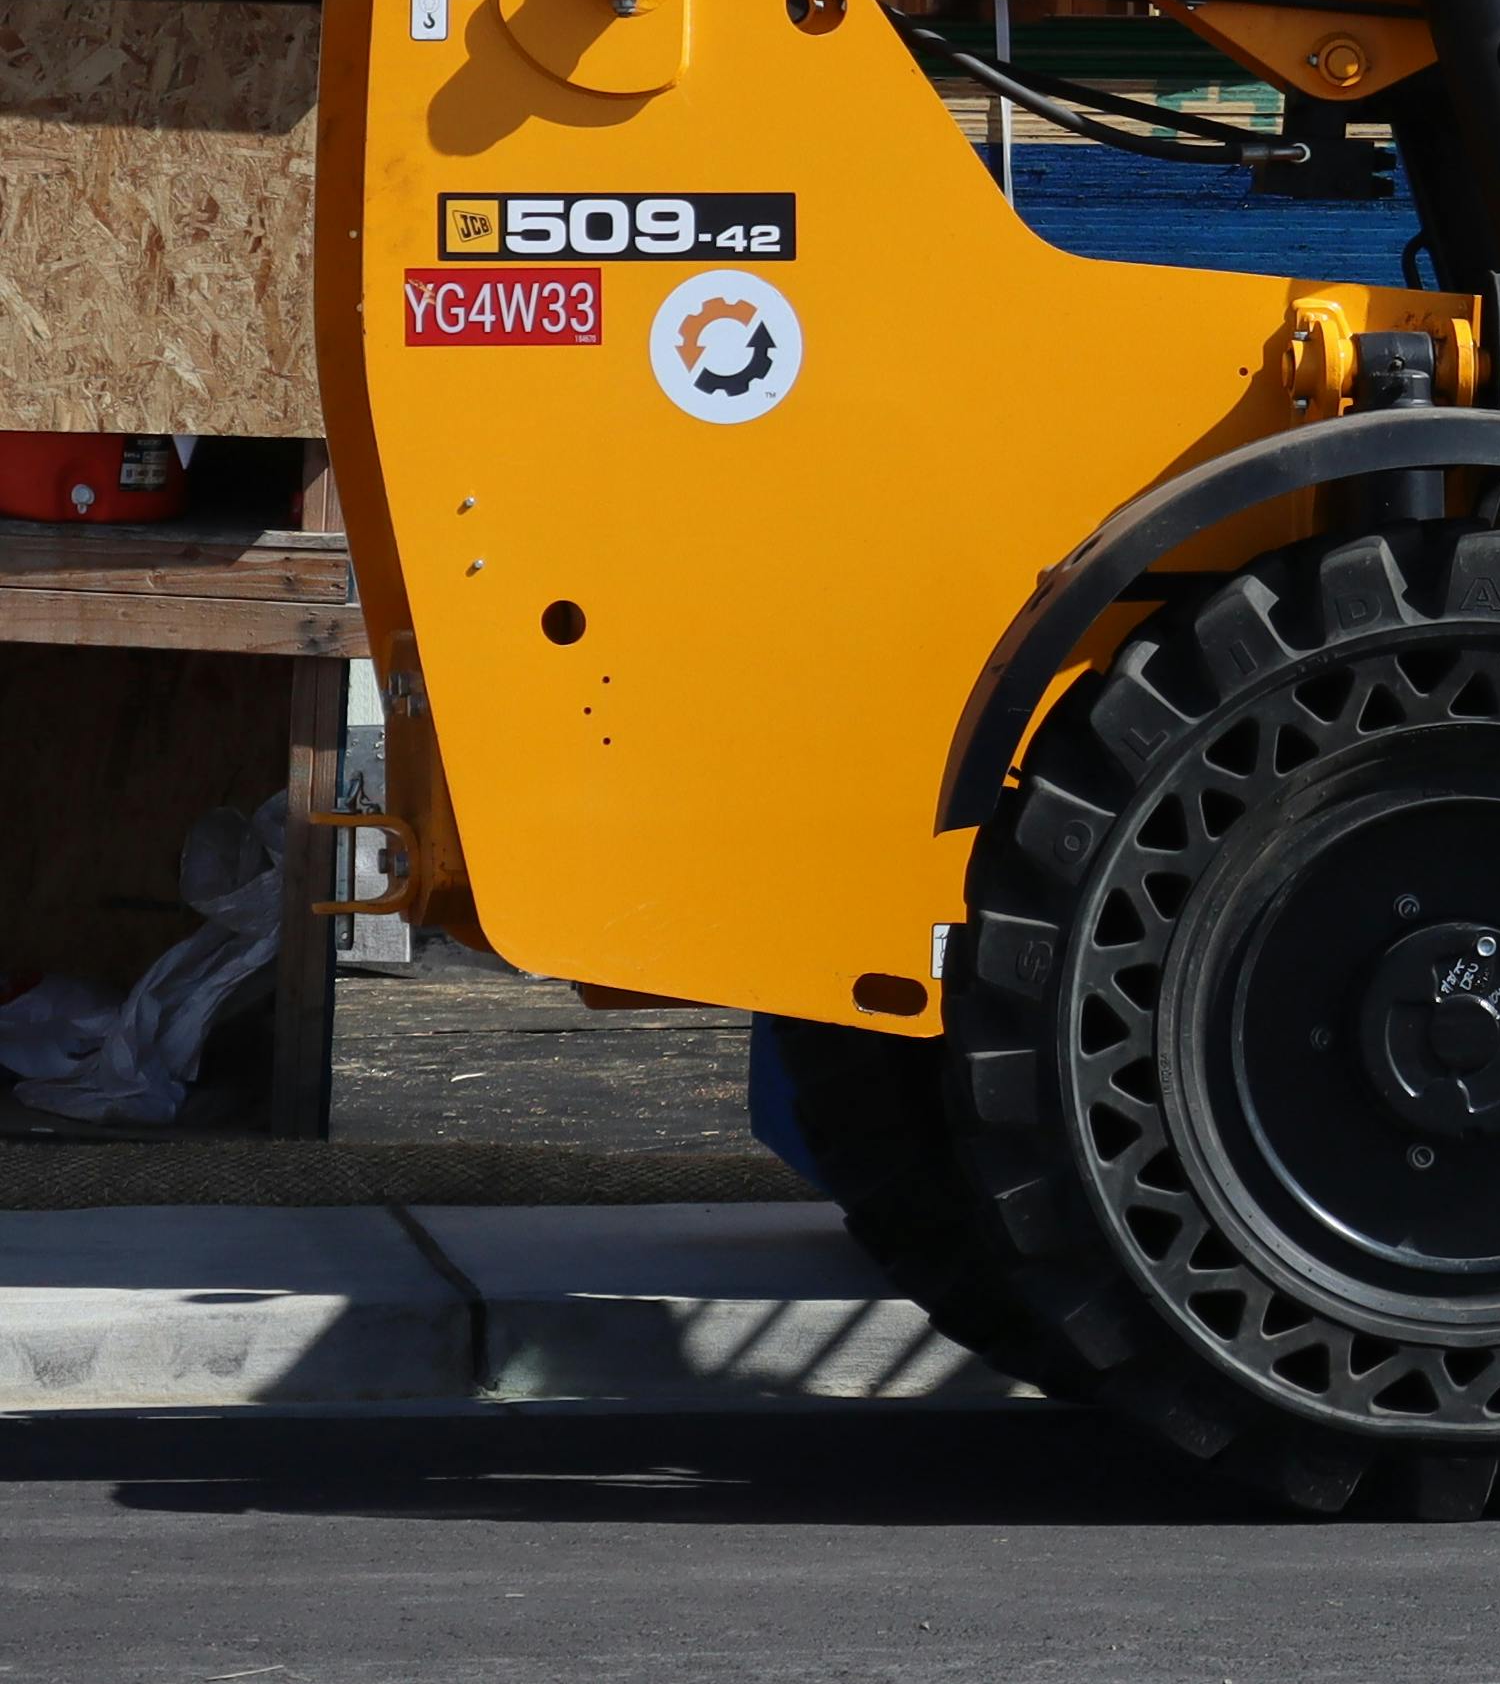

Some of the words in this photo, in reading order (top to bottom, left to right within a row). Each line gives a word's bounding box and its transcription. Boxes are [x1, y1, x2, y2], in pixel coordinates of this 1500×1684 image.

[459, 213, 490, 238] JCB
[505, 199, 781, 254] 509-42
[404, 281, 595, 334] YG4W33
